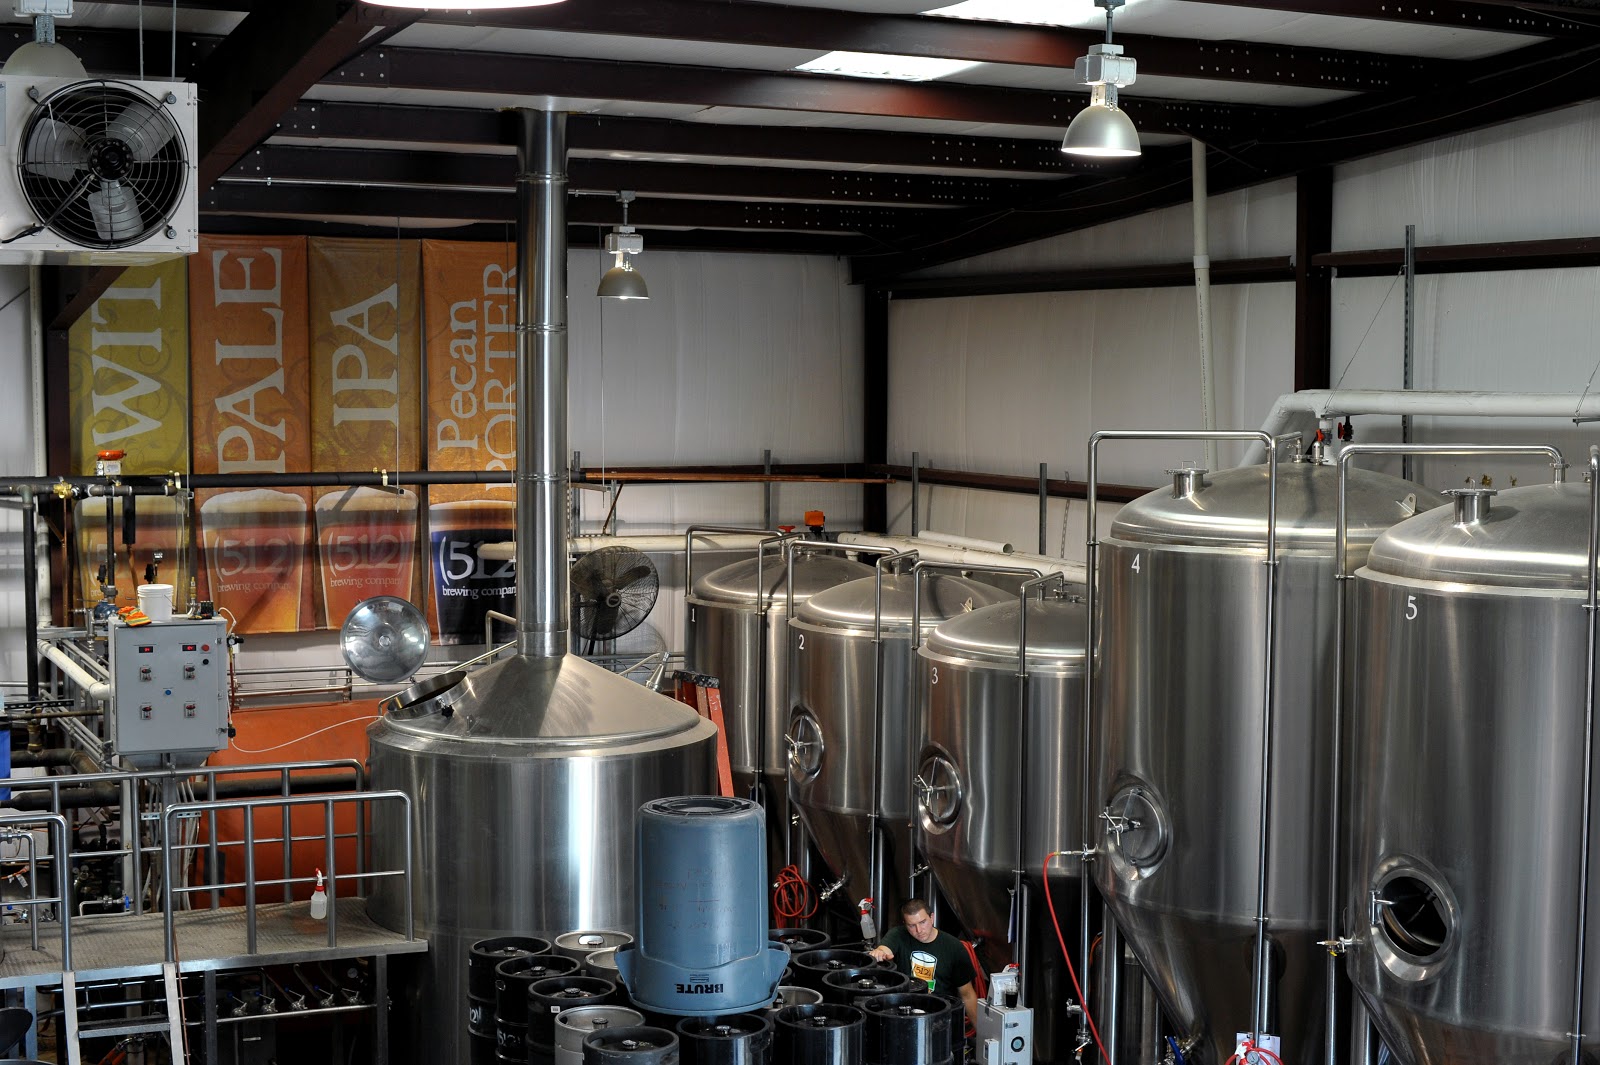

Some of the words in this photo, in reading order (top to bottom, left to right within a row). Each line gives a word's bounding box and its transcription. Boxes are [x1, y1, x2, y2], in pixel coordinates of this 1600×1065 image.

[213, 247, 285, 474] PALE
[330, 282, 398, 427] IPA
[437, 298, 479, 451] Pecan
[214, 533, 294, 582] (512)
[328, 531, 405, 577] (512)
[1131, 553, 1141, 574] 4
[217, 581, 250, 593] brewing
[330, 576, 362, 588] brewing
[365, 577, 401, 587] compan
[442, 585, 479, 599] brewing
[481, 586, 517, 598] compan
[691, 608, 696, 623] 1
[1405, 595, 1418, 620] 5
[799, 634, 805, 650] 2
[931, 667, 939, 685] 3
[676, 984, 724, 994] BRUTE
